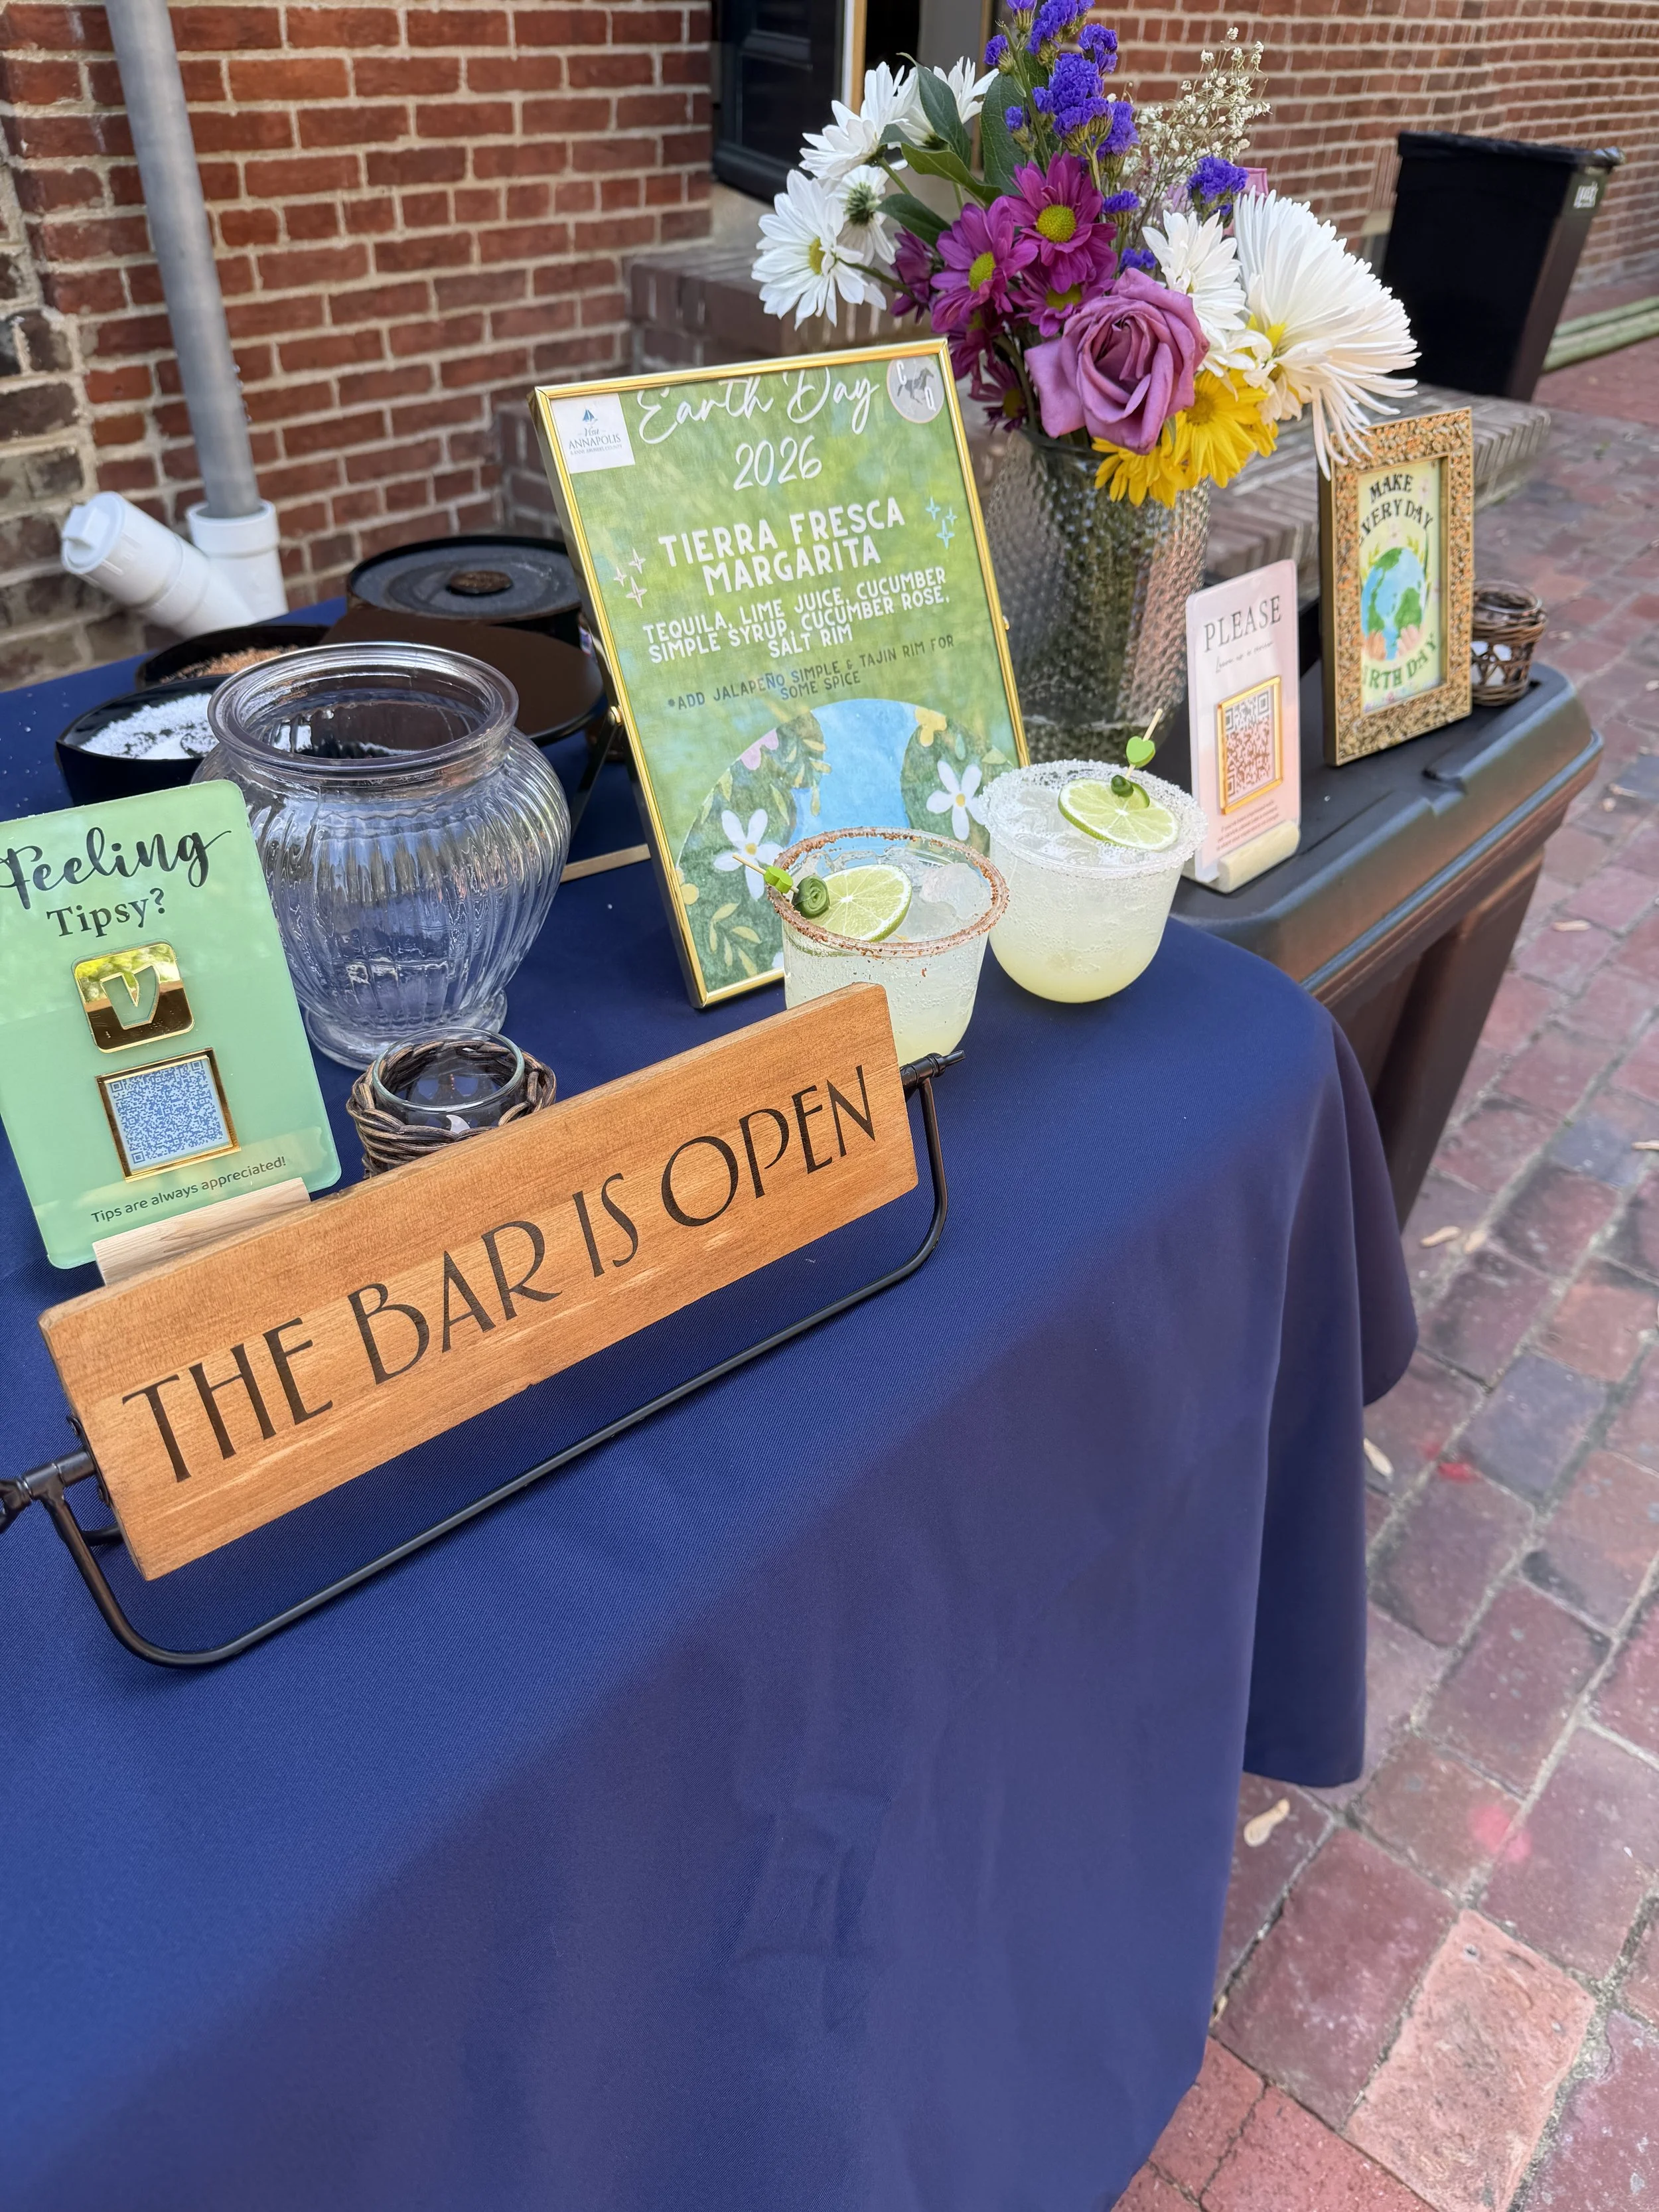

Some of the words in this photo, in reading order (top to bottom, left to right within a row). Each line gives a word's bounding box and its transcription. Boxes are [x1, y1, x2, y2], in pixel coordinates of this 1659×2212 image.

[637, 376, 774, 445] Earth
[782, 366, 880, 435] Day
[569, 434, 621, 450] ANNAPOLIS
[733, 435, 823, 491] 2026
[1369, 473, 1414, 504] MAKE
[658, 519, 778, 567] TIERRA
[789, 496, 906, 546] FRESCA
[1359, 498, 1402, 546] VERY
[702, 535, 882, 597] MARGARITA
[642, 611, 733, 644] TEQUILA,
[739, 599, 785, 625] LIME
[794, 587, 850, 613] JUICE,
[856, 566, 946, 600] CUCUMBER
[648, 632, 721, 664] SIMPLE
[801, 597, 895, 631] CUCUMBER
[901, 585, 950, 611] ROSE,
[1204, 595, 1282, 652] PLEASE
[713, 672, 785, 701] JALAPEÑO
[791, 661, 840, 684] SIMPLE
[846, 659, 854, 670] &
[859, 648, 897, 668] TAJIN
[902, 641, 925, 658] RIM
[931, 634, 954, 652] FOR
[768, 631, 811, 658] SALT
[820, 624, 853, 647] RIM
[780, 681, 818, 701] SOME
[824, 671, 861, 691] SPICE
[0, 827, 232, 910] Feeling
[46, 888, 165, 938] Tipsy?
[91, 1206, 122, 1222] Tips
[125, 1199, 149, 1213] are
[151, 1183, 198, 1205] always
[201, 1156, 286, 1190] appreciated!
[122, 1317, 332, 1483] THE
[347, 1220, 563, 1385] BAR
[572, 1173, 638, 1278] IS
[661, 1065, 875, 1227] OPEN
